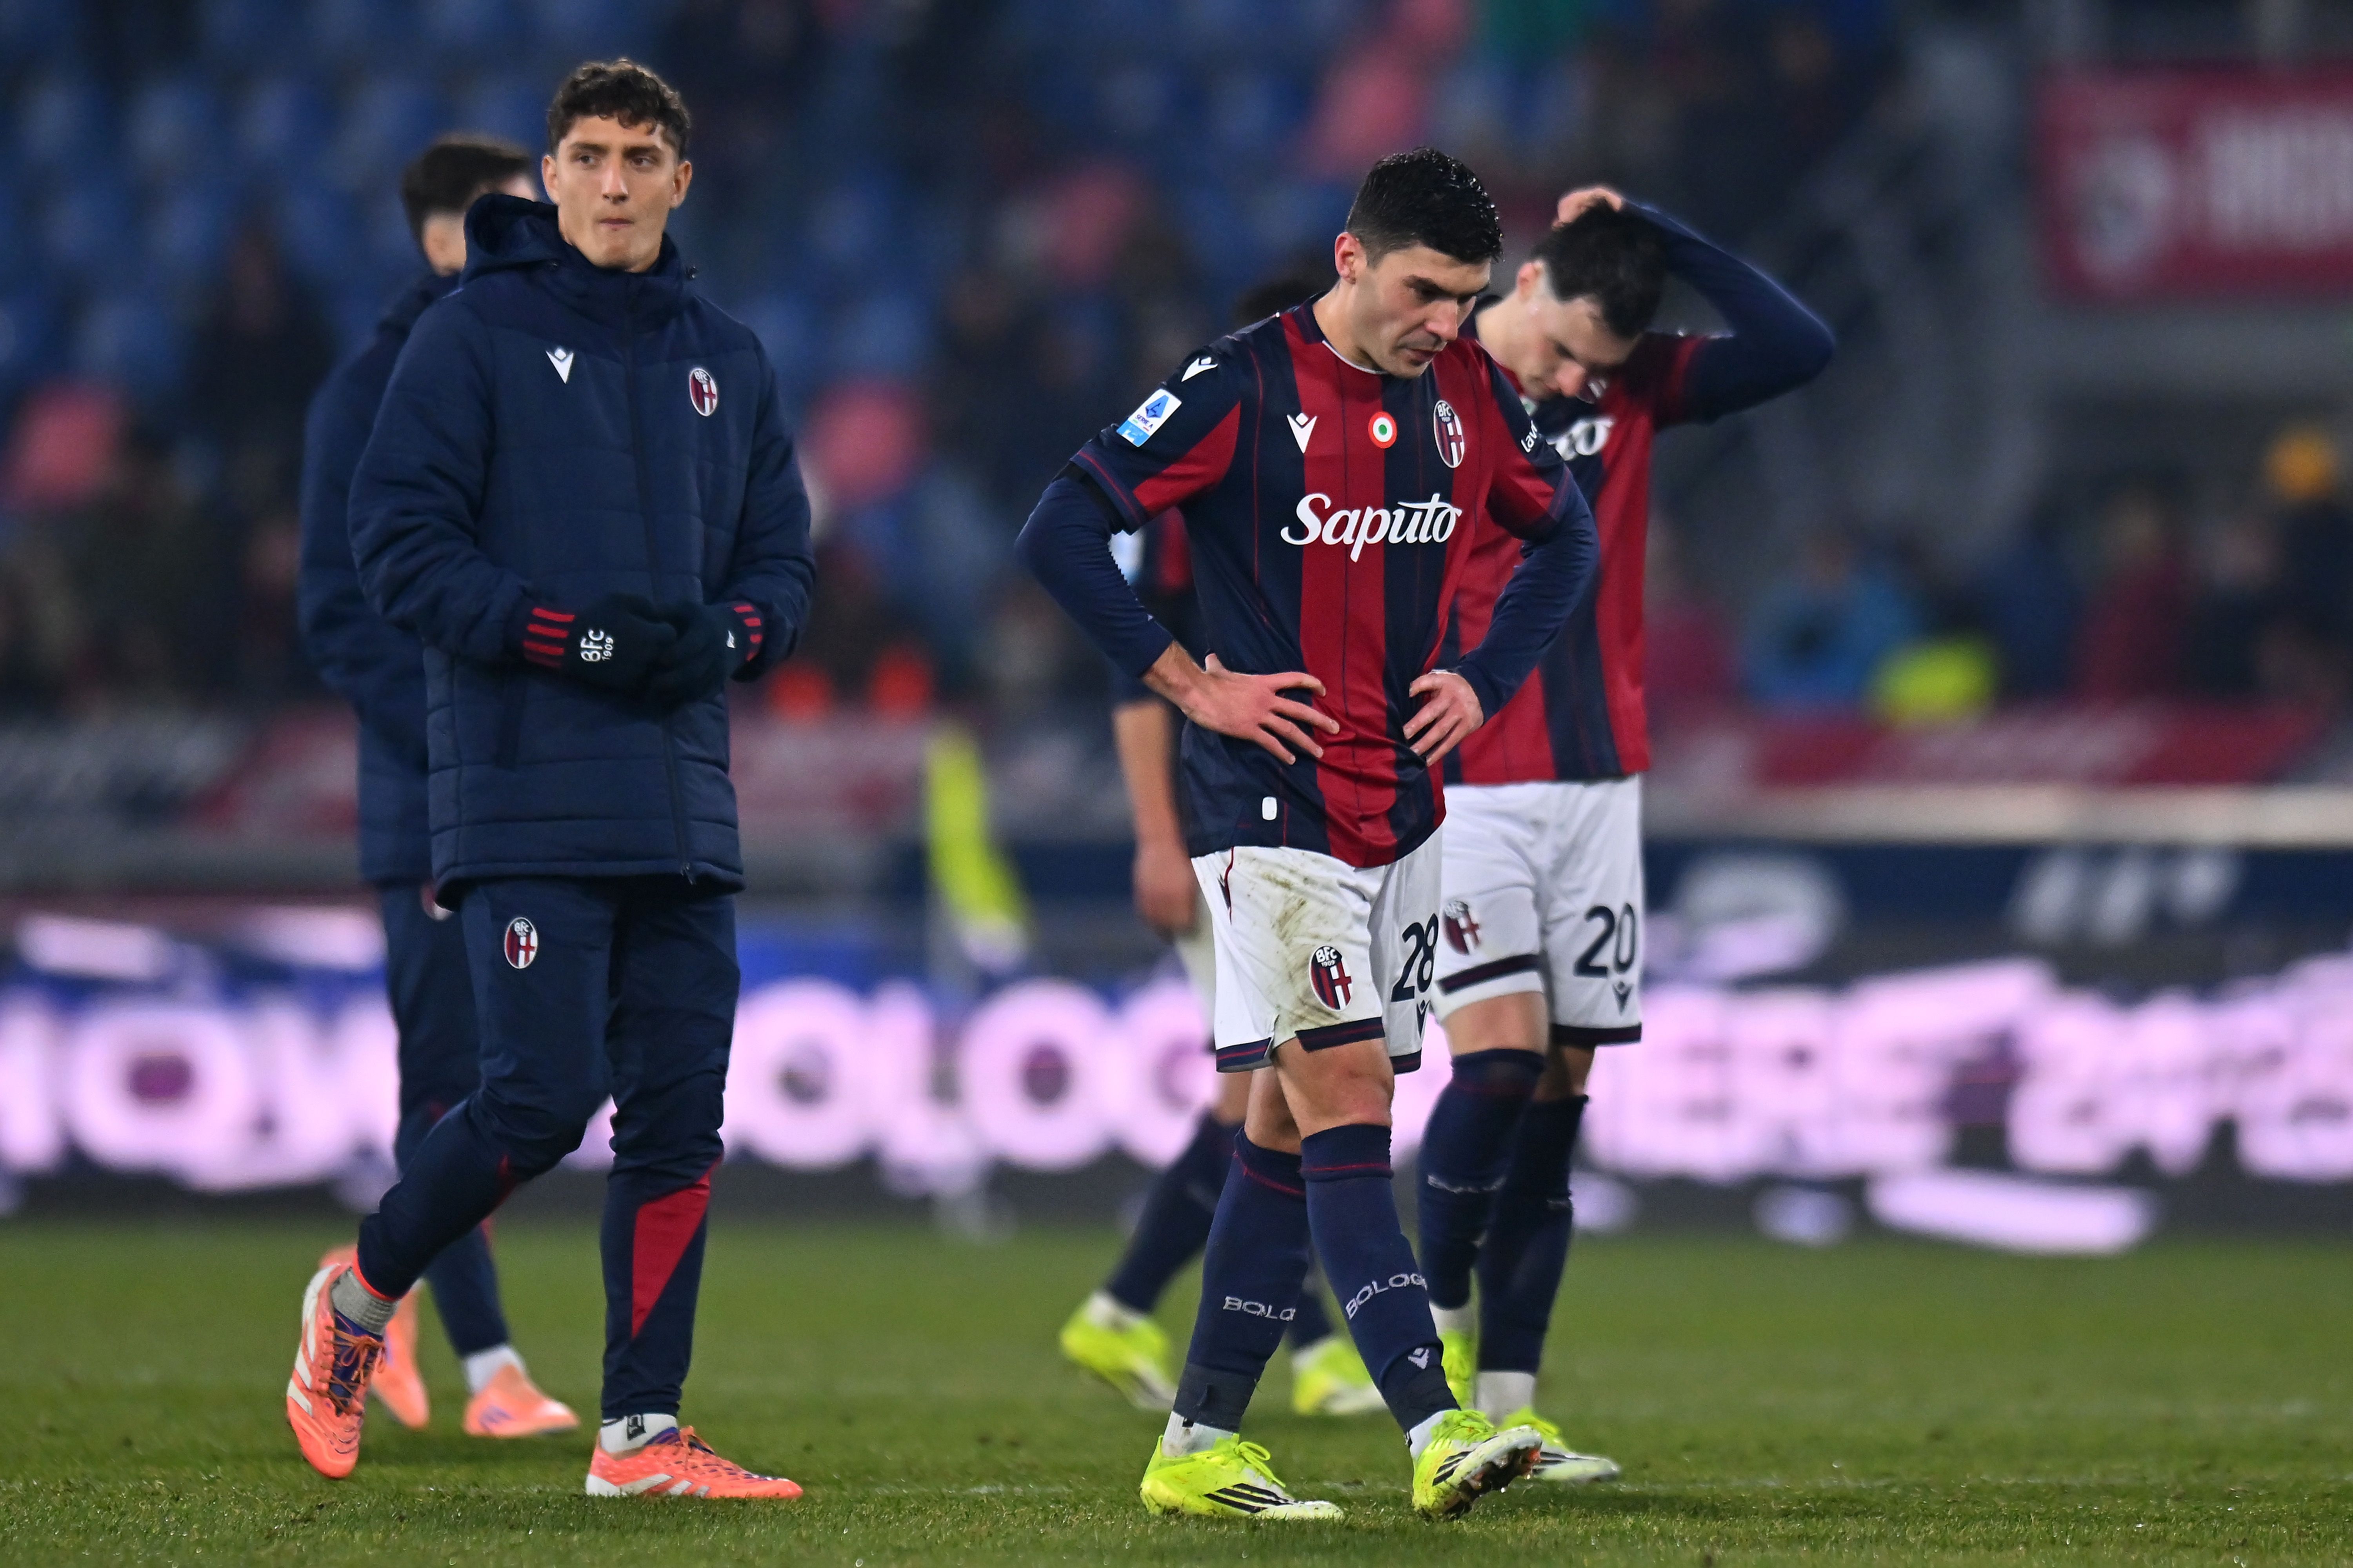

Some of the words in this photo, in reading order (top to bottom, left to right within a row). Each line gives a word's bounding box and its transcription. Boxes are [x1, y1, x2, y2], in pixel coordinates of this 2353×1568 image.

[1135, 414, 1149, 426] SERIE
[1437, 403, 1451, 417] BFC
[1280, 493, 1462, 563] Saputo
[580, 629, 604, 662] BFC
[602, 637, 613, 661] 1909
[1573, 903, 1636, 978] 20
[1315, 947, 1337, 963] BFC
[1391, 913, 1438, 1002] 28
